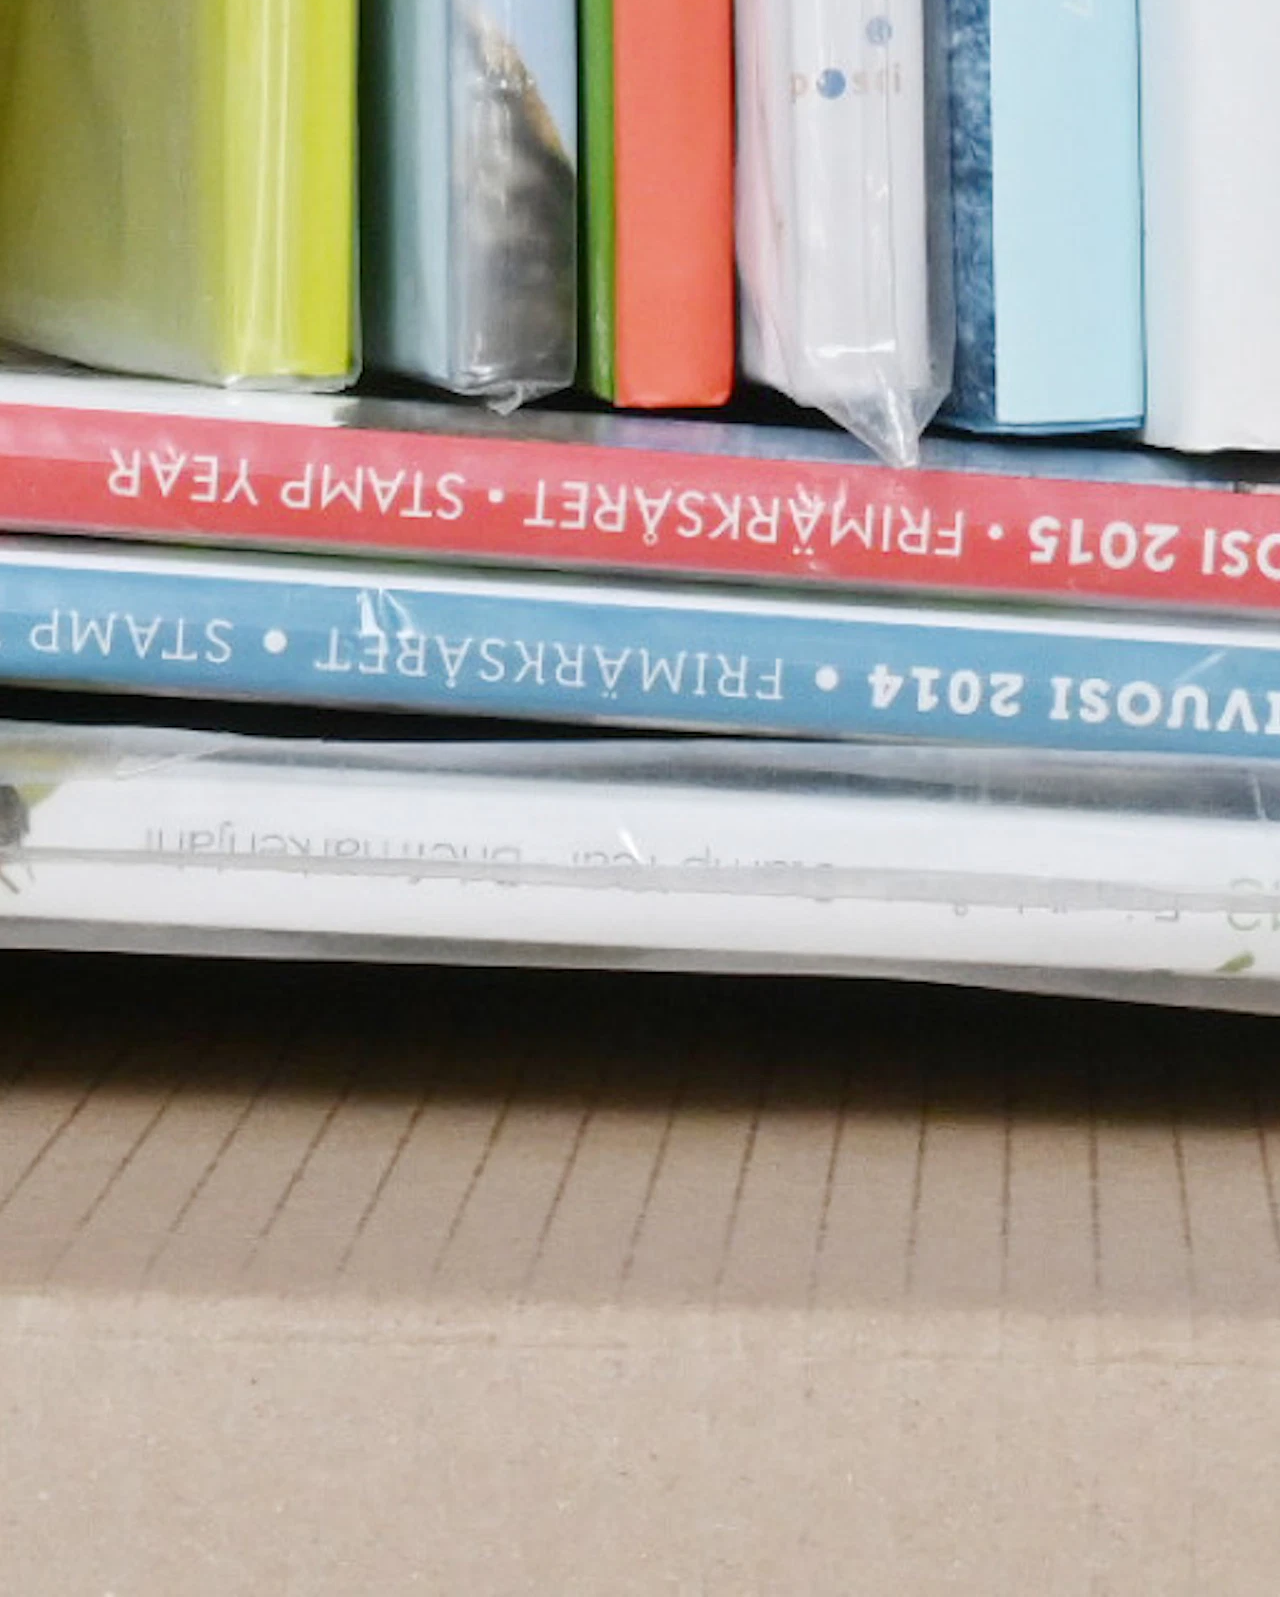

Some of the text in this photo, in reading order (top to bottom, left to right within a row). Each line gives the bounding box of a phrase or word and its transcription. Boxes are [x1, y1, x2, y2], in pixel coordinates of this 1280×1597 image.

[107, 449, 257, 505] YEAR
[281, 462, 466, 520] STAMP
[524, 478, 964, 559] FRIMÄRKSÅRET
[1029, 515, 1178, 571] 2015
[28, 608, 233, 663] STAMP
[315, 624, 784, 703] FRIMÄRKSÅRET
[867, 662, 1025, 715] 2014
